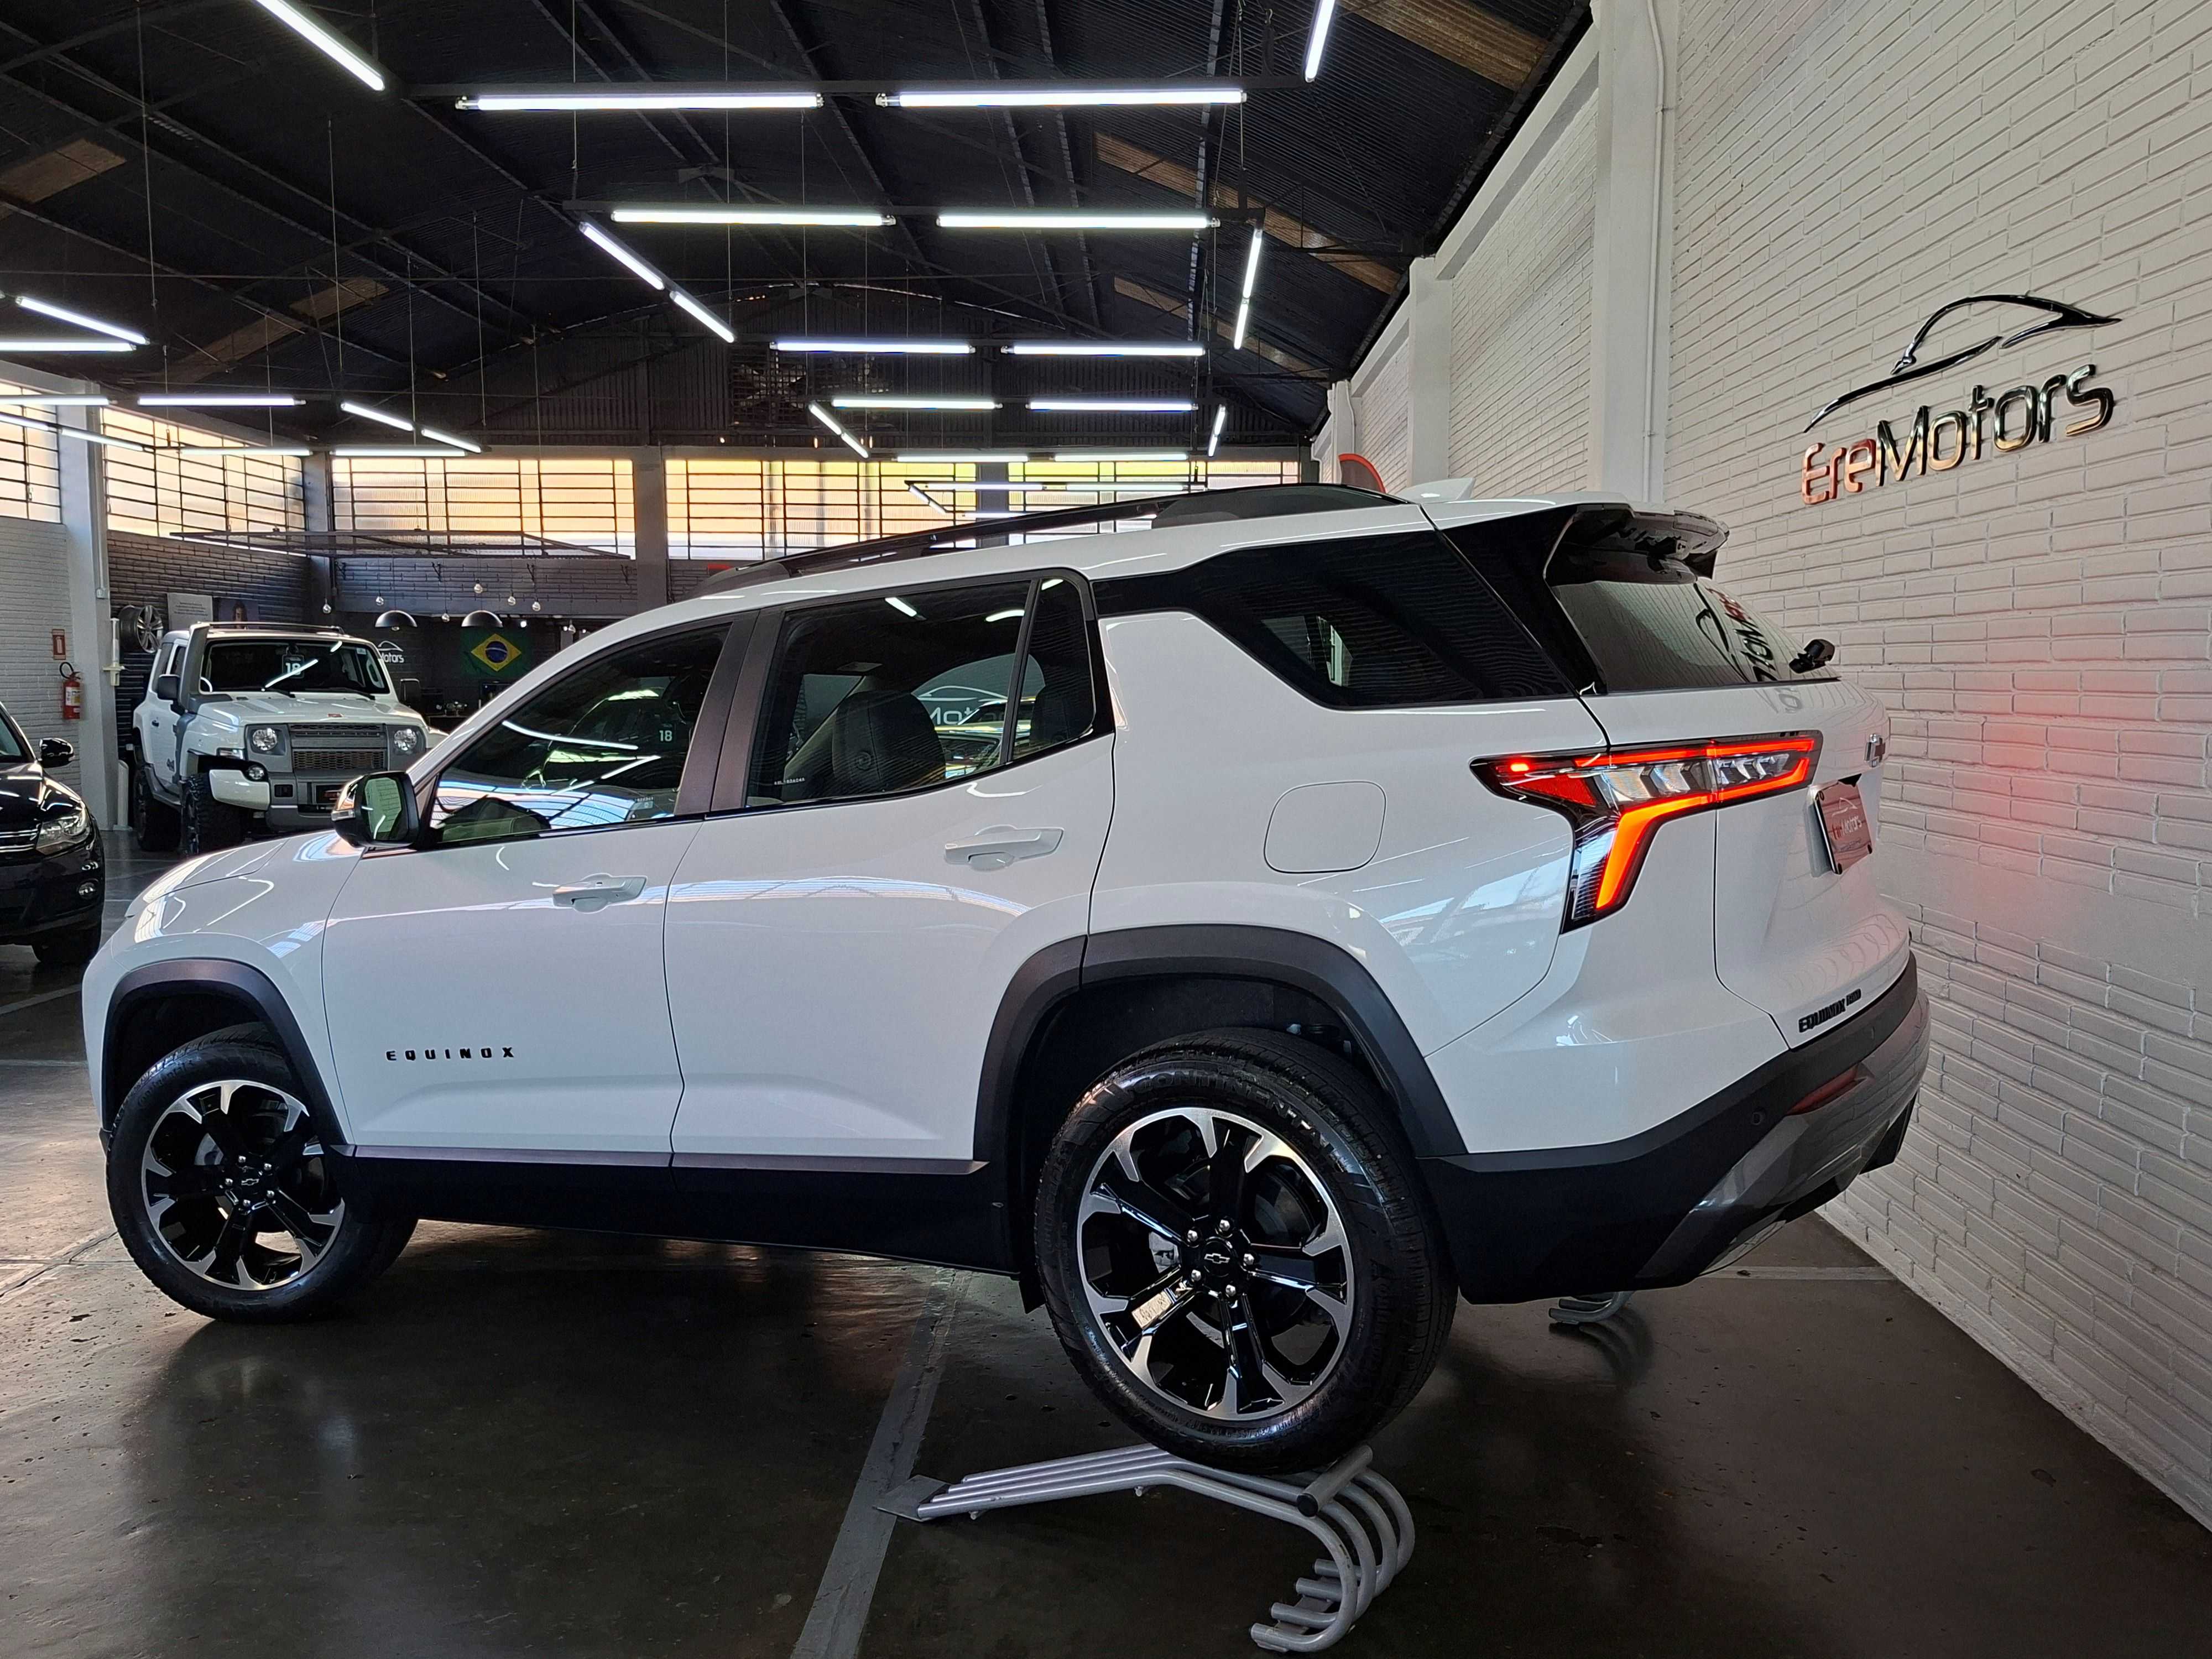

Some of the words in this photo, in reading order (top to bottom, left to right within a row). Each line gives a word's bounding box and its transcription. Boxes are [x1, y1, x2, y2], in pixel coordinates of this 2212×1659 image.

[1801, 364, 2114, 505] EreMotors
[659, 730, 672, 742] 18
[386, 1047, 514, 1061] EQUINOX
